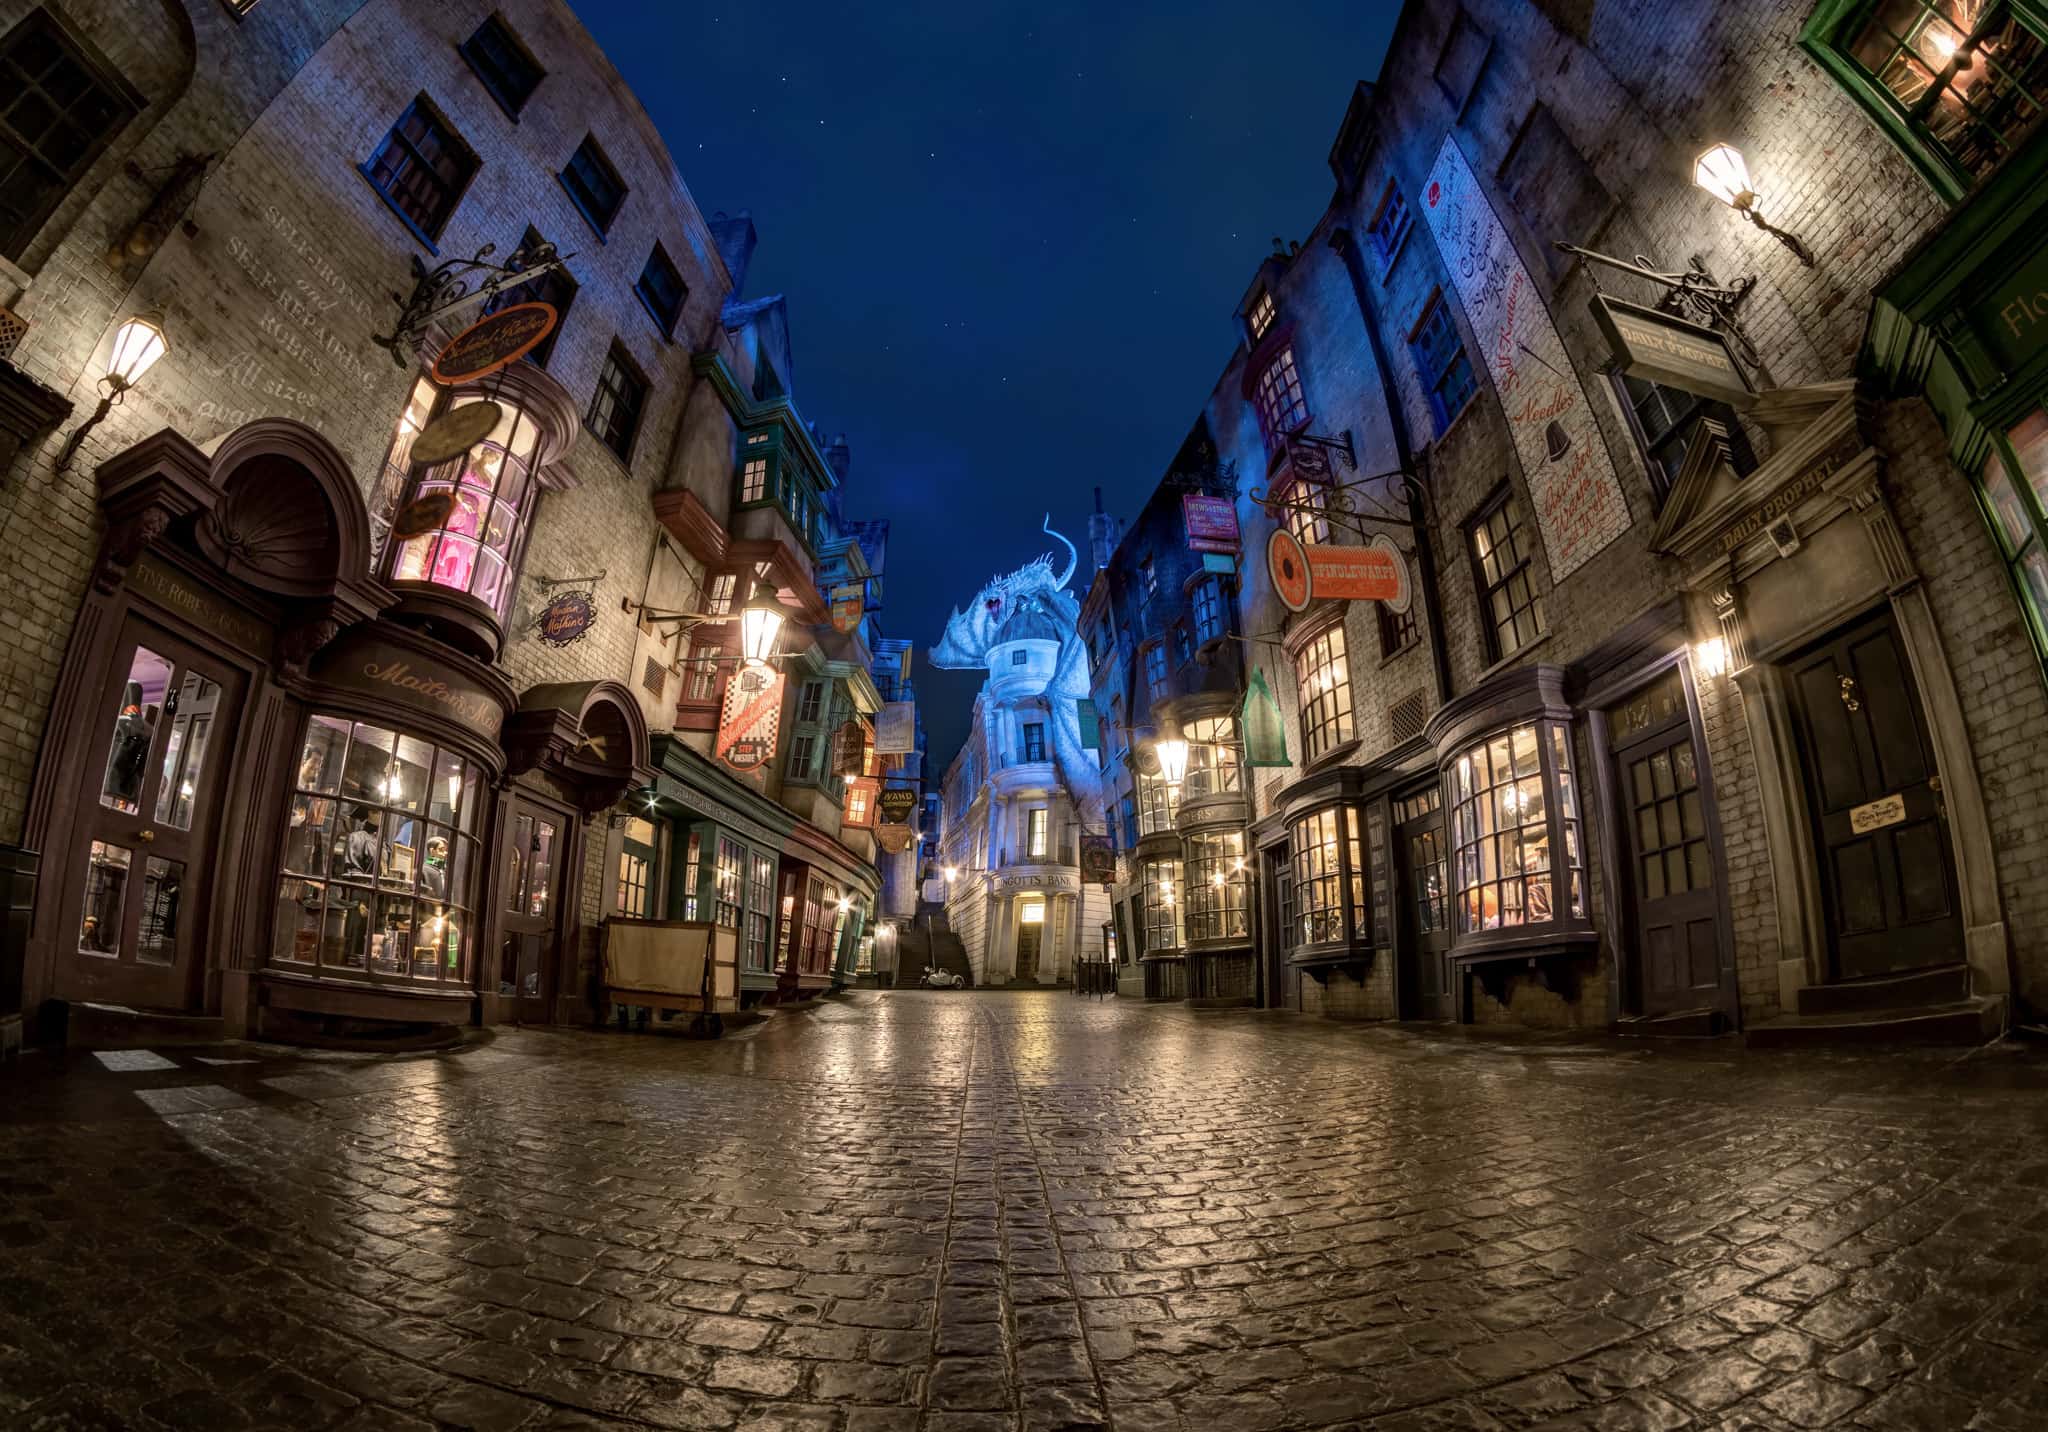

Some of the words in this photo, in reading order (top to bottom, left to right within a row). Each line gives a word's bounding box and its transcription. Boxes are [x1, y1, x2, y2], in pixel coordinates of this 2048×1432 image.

[296, 279, 339, 311] and
[259, 314, 321, 377] ROBES
[1620, 326, 1665, 350] DAILY
[1665, 339, 1732, 371] PROPHET
[262, 378, 318, 408] sizes
[1513, 384, 1577, 424] Needles
[1723, 510, 1761, 549] DAILY
[1763, 457, 1836, 520] PROPHET
[136, 563, 168, 594] FINE
[884, 791, 913, 801] WAND
[1047, 874, 1073, 887] BANK
